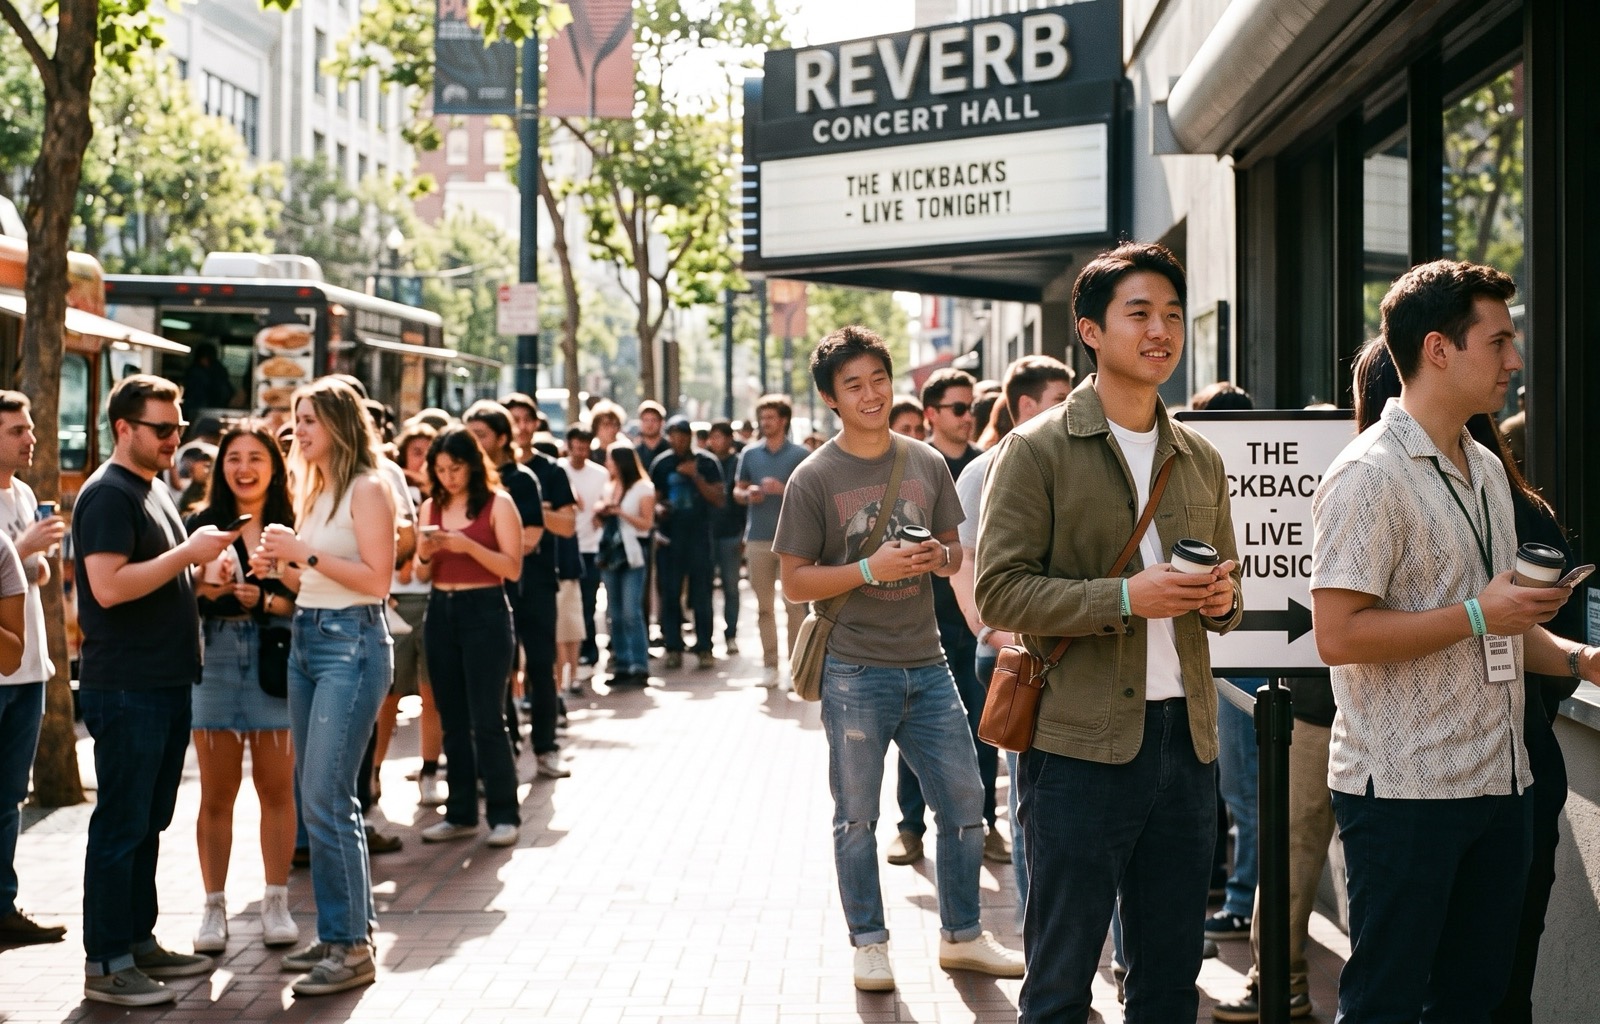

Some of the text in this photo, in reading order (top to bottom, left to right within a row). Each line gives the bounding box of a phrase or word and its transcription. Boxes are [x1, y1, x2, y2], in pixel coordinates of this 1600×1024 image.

[794, 13, 1070, 113] REVERB
[812, 93, 1040, 144] CONCERT HALL
[846, 160, 1007, 198] THE KICKBACKS
[862, 199, 905, 224] LIVE
[916, 190, 1012, 222] TONIGHT!
[1246, 442, 1299, 465] THE
[1245, 522, 1303, 546] LIVE
